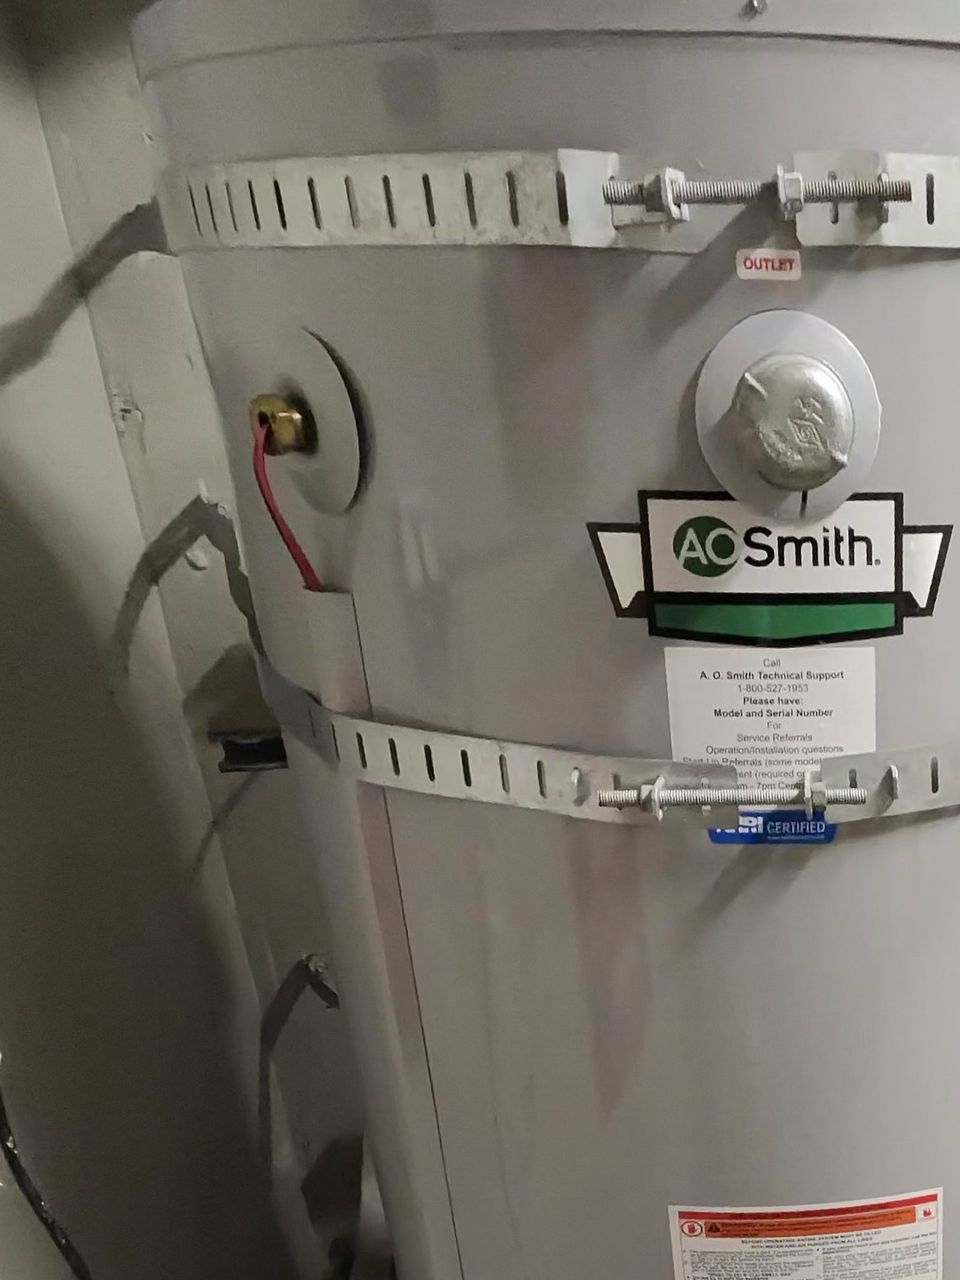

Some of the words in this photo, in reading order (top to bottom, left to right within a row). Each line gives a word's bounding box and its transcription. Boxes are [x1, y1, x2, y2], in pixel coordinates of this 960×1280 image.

[743, 257, 795, 272] OUTLET
[743, 526, 873, 567] Smith
[763, 658, 781, 668] Call
[699, 671, 710, 680] A.
[713, 671, 724, 680] O.
[726, 671, 755, 680] Smith
[758, 671, 804, 680] Technical
[806, 671, 844, 681] Support
[738, 683, 809, 693] 1-800-527-1953
[743, 696, 775, 706] Please
[778, 697, 804, 706] have:
[714, 709, 743, 718] Model
[746, 709, 764, 718] and
[766, 709, 793, 718] Serial
[796, 709, 834, 718] Number
[767, 721, 782, 730] For
[737, 733, 771, 743] Service
[773, 733, 813, 743] Referrals
[706, 745, 799, 755] Operation/Installation
[802, 745, 844, 755] questions
[722, 757, 763, 767] Referrals
[765, 758, 792, 768] (some
[755, 771, 795, 780] (required
[767, 821, 826, 834] CERTIFIED
